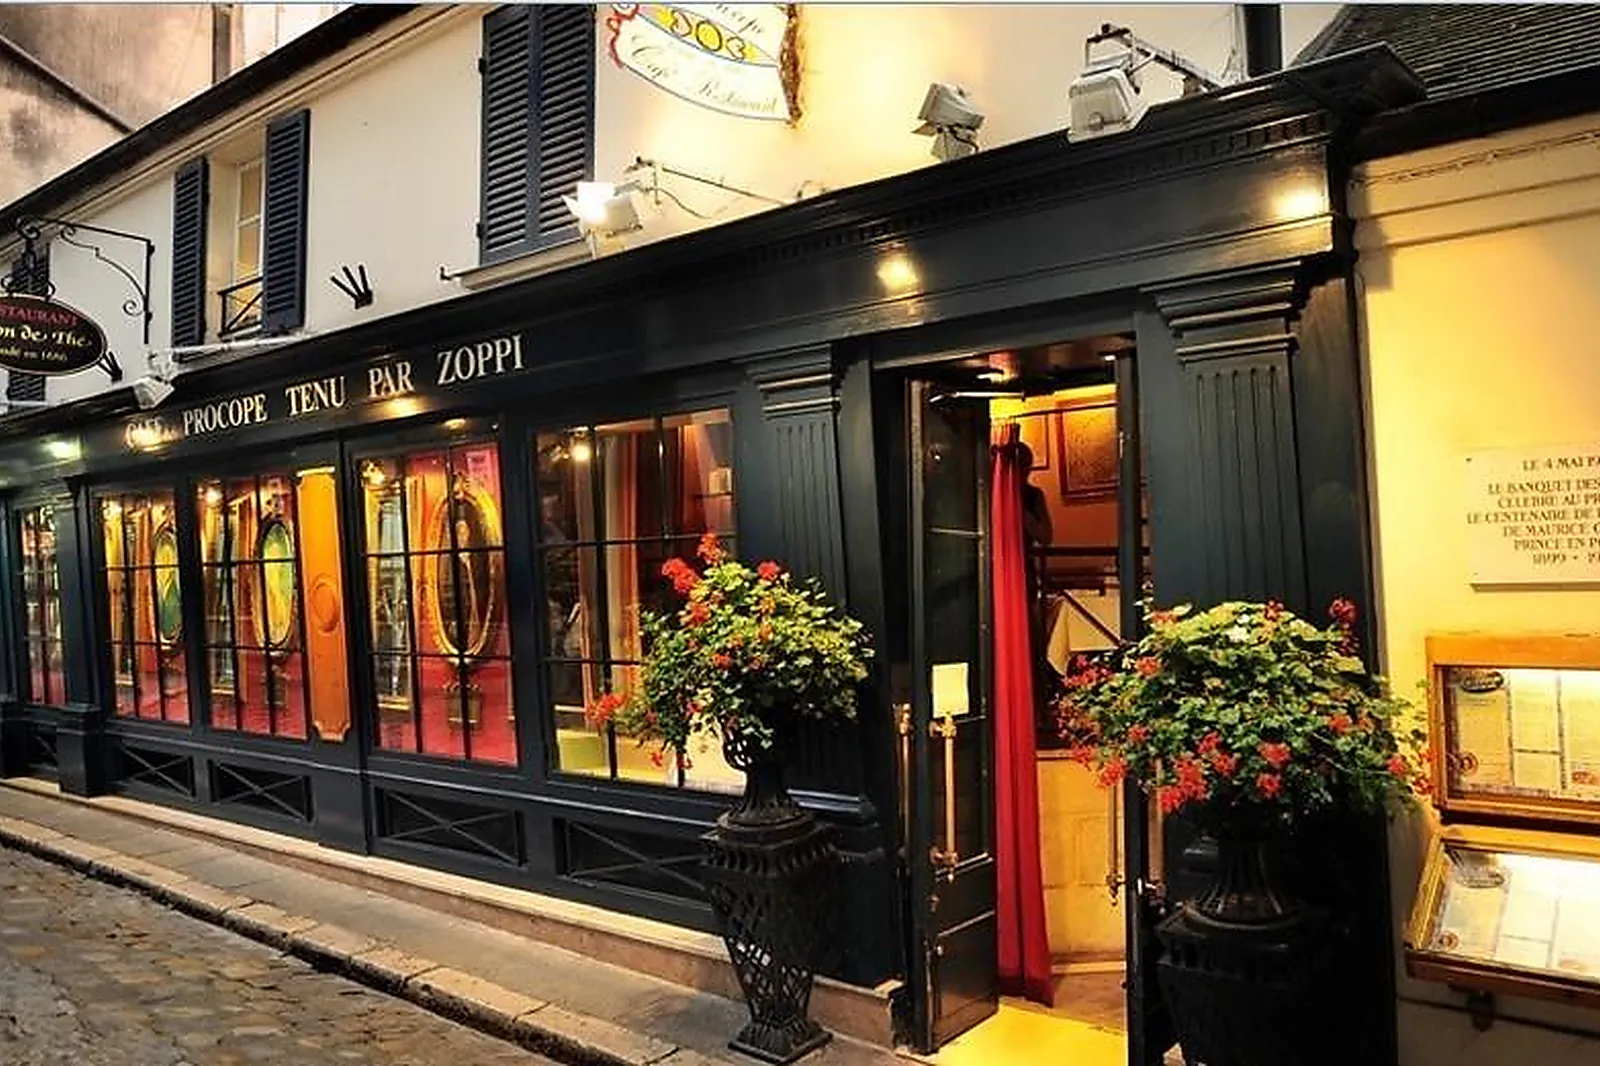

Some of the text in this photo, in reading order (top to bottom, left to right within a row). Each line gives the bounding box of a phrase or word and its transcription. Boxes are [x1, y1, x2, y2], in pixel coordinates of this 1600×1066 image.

[21, 324, 47, 341] de
[182, 393, 268, 437] PROCOPE
[285, 375, 346, 417] TENU
[367, 361, 416, 400] PAR
[437, 334, 525, 386] ZOPPI
[1556, 456, 1583, 469] MAI
[1507, 479, 1572, 493] BANQUET
[1485, 509, 1566, 524] CENTENAIRE
[1525, 523, 1586, 536] MAURICE
[1513, 538, 1561, 551] PRINCE
